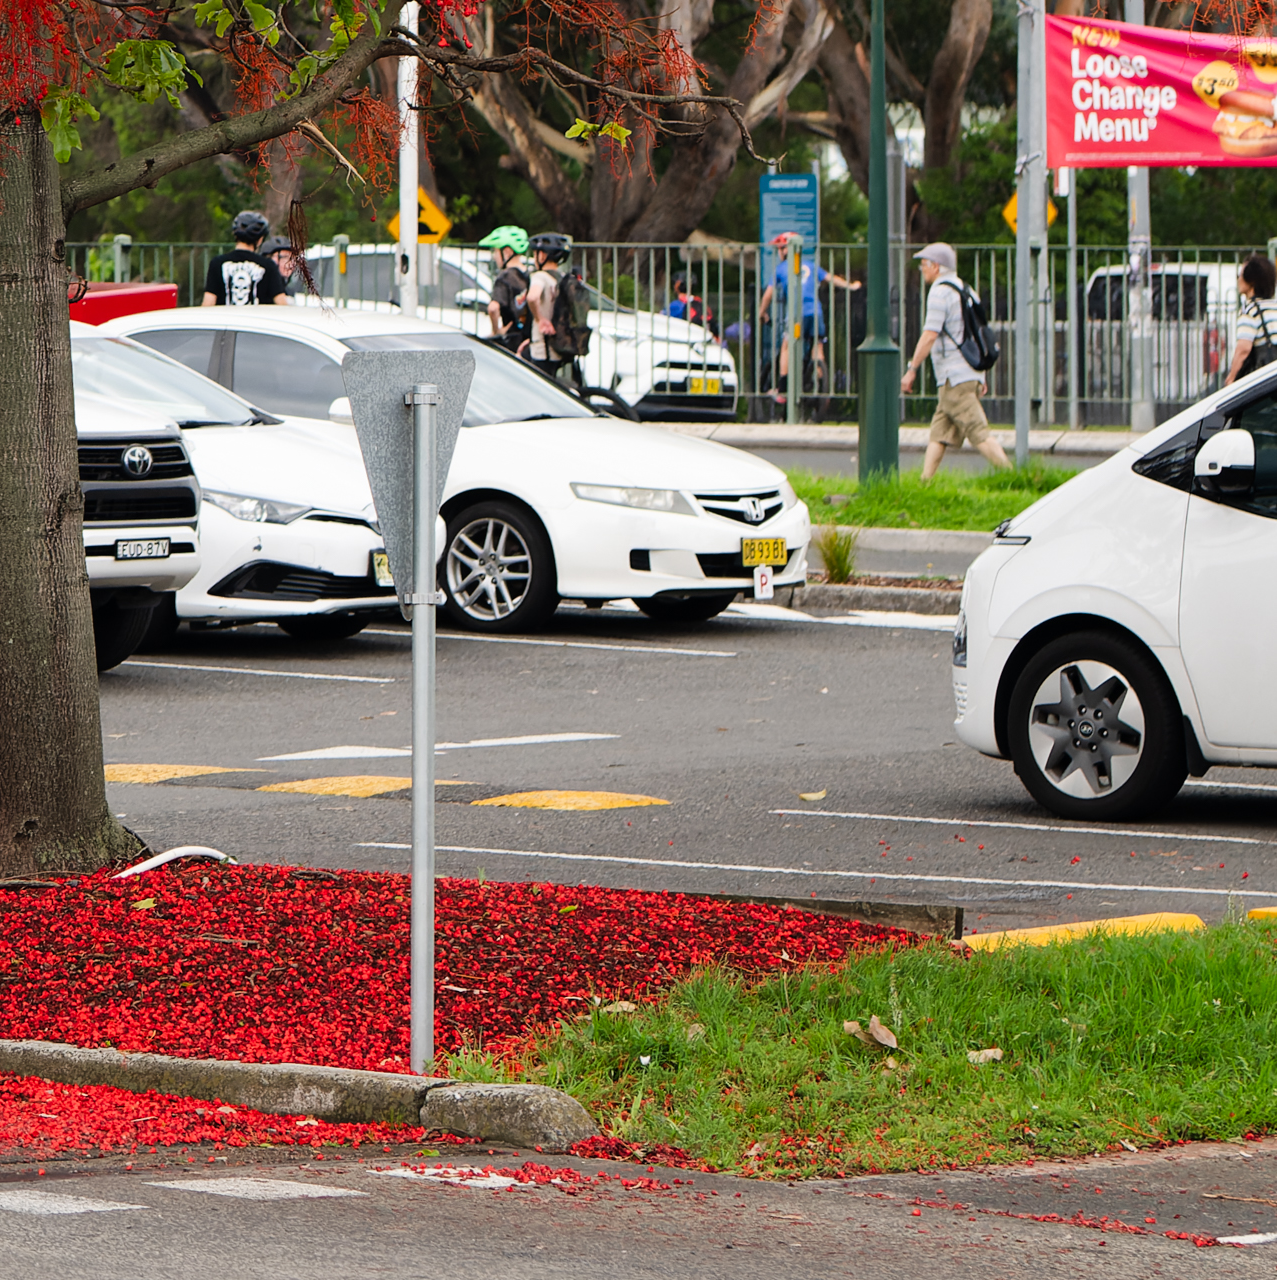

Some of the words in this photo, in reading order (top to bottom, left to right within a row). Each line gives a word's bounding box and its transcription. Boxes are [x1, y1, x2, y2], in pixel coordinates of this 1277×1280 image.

[1072, 25, 1121, 48] NEW
[1071, 48, 1149, 78] Loose
[1072, 79, 1177, 118] Change
[760, 573, 768, 594] P
